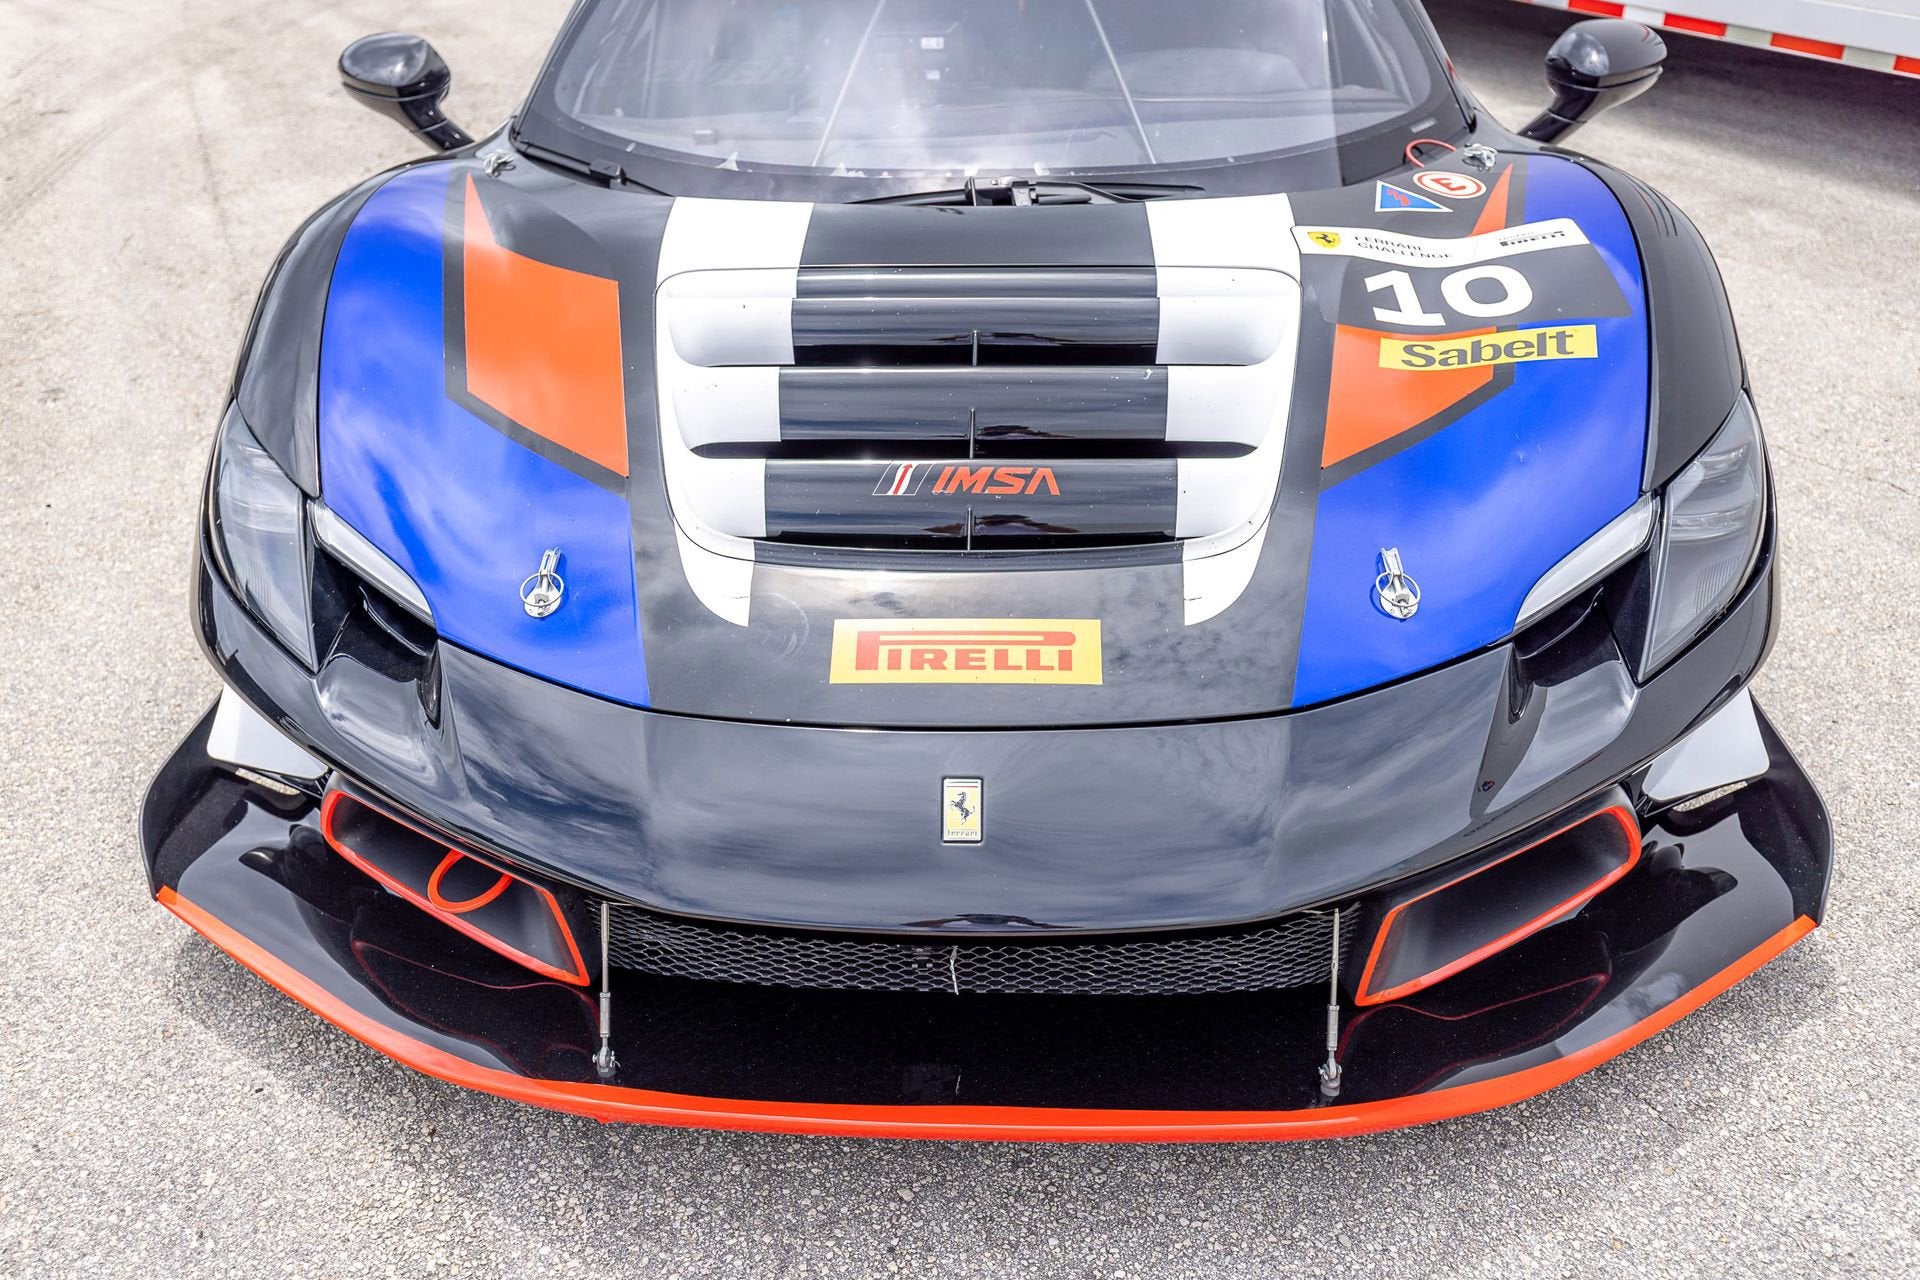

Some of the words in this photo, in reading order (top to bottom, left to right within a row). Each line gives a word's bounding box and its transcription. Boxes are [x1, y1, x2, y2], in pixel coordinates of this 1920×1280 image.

[1354, 236, 1422, 251] FERRARI
[1357, 242, 1450, 259] CHALLENGE
[1364, 265, 1533, 326] 10
[1401, 330, 1574, 368] Sabelt
[932, 466, 1061, 496] IMSA
[855, 631, 1077, 671] PIRELLI
